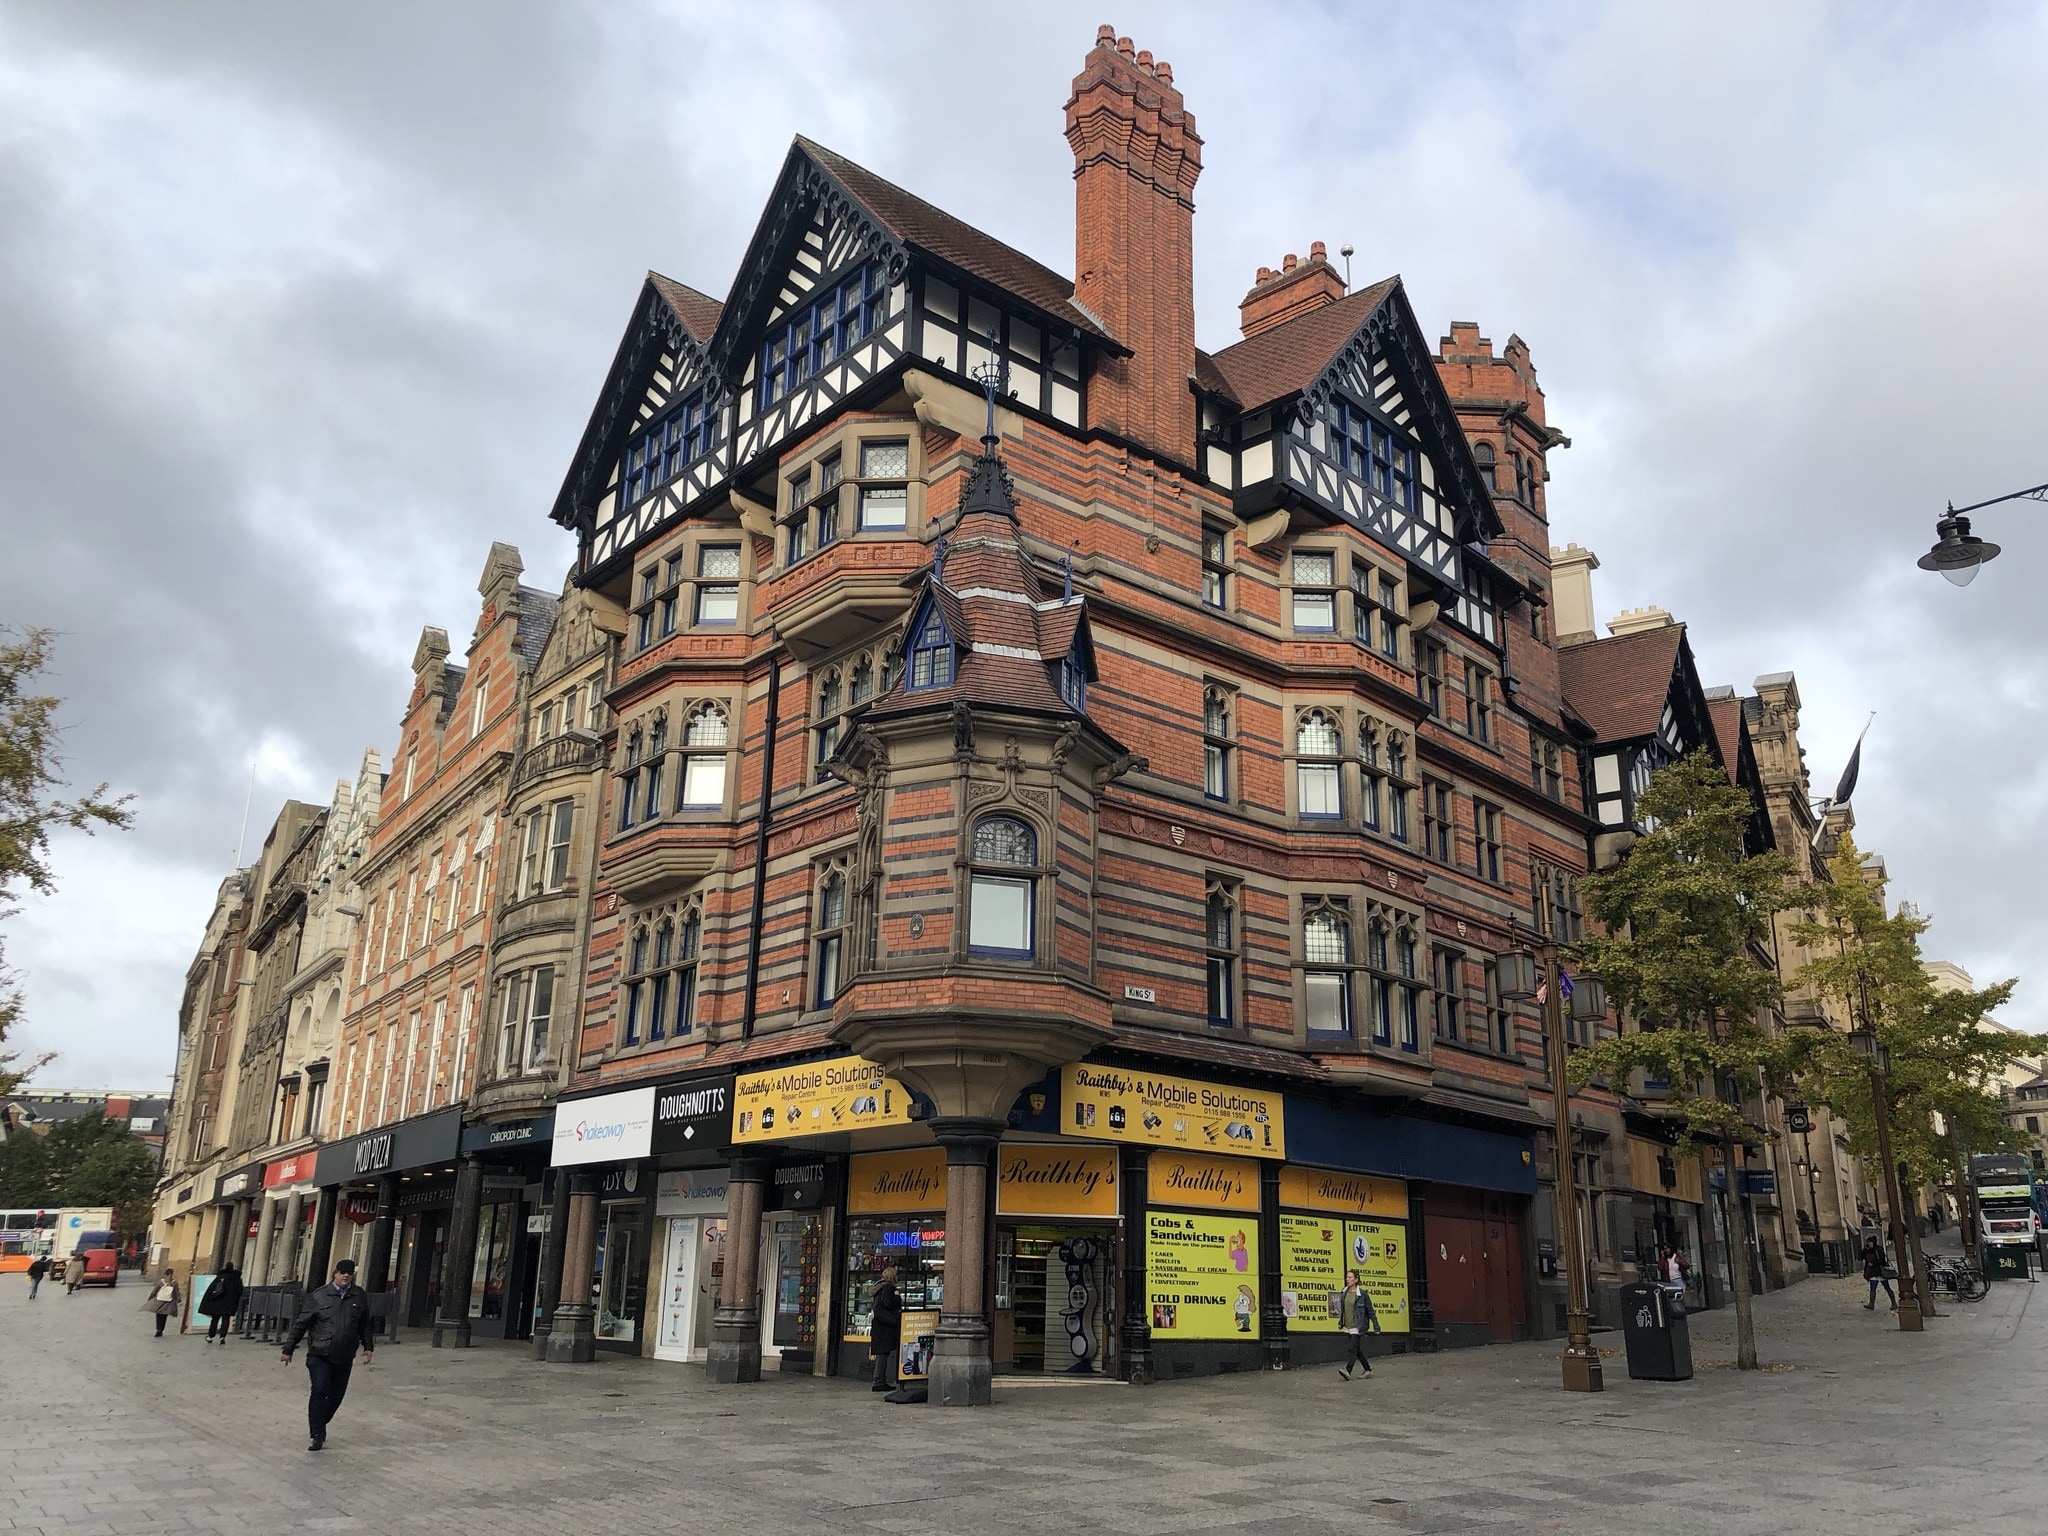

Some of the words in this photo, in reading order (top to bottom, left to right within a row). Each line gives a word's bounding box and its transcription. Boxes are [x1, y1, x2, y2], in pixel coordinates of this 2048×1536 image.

[738, 1077, 776, 1097] Raithby's
[776, 1081, 782, 1090] &
[781, 1071, 821, 1092] Mobile
[825, 1063, 884, 1085] Solutions
[781, 1092, 798, 1101] Repair
[798, 1090, 816, 1099] Centre
[1076, 1069, 1133, 1096] Raithby's
[1136, 1081, 1145, 1094] &
[1148, 1080, 1197, 1104] Mobile
[1202, 1089, 1266, 1114] Solutions
[659, 1087, 725, 1121] DOUGHNOTTS
[1141, 1096, 1162, 1108] Repair
[1164, 1099, 1186, 1110] Centre
[576, 1120, 626, 1142] Shakeaway
[354, 1139, 372, 1173] MOD
[369, 1134, 392, 1170] PIZZA
[775, 1164, 824, 1185] DOUGHNOTTS
[1001, 1158, 1116, 1195] Raithby's
[873, 1165, 939, 1201] Raithby's
[1166, 1163, 1242, 1202] Raithby's
[681, 1178, 728, 1202] Shakeaway
[1318, 1176, 1374, 1211] Raithby's
[350, 1198, 377, 1213] MOD
[1150, 1217, 1181, 1229] Cobs
[1185, 1219, 1195, 1229] &
[1281, 1217, 1293, 1225] HOT
[1295, 1219, 1318, 1227] DRINKS
[1348, 1224, 1380, 1233] LOTTERY
[883, 1231, 910, 1247] SLUSH
[1150, 1229, 1225, 1243] Sandwiches
[1292, 1247, 1331, 1256] NEWSPAPERS
[1294, 1256, 1329, 1264] MAGAZINES
[1999, 1257, 2017, 1268] Bill's
[1288, 1281, 1336, 1290] TRADITIONAL
[1151, 1294, 1180, 1304] COLD
[1184, 1295, 1226, 1305] DRINKS
[1298, 1293, 1327, 1302] BAGGED
[1298, 1304, 1327, 1313] SWEETS
